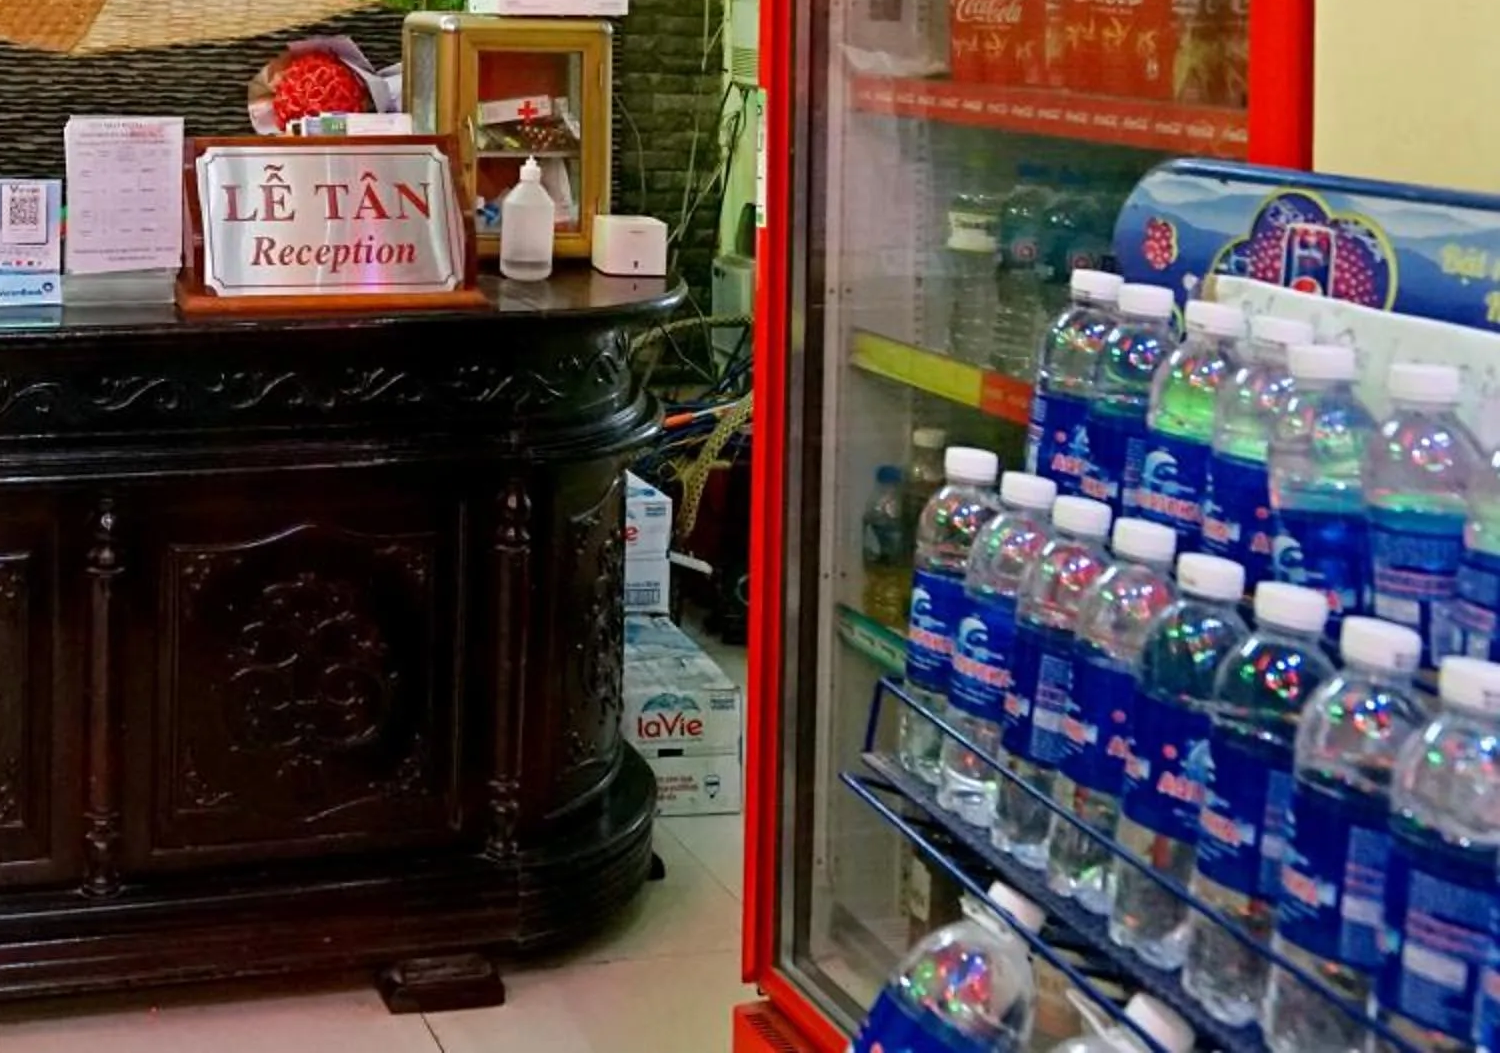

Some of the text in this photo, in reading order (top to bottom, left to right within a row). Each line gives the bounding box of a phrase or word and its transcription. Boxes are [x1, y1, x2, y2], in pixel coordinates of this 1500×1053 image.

[220, 164, 431, 222] LỄ TÂN
[251, 235, 416, 274] Reception
